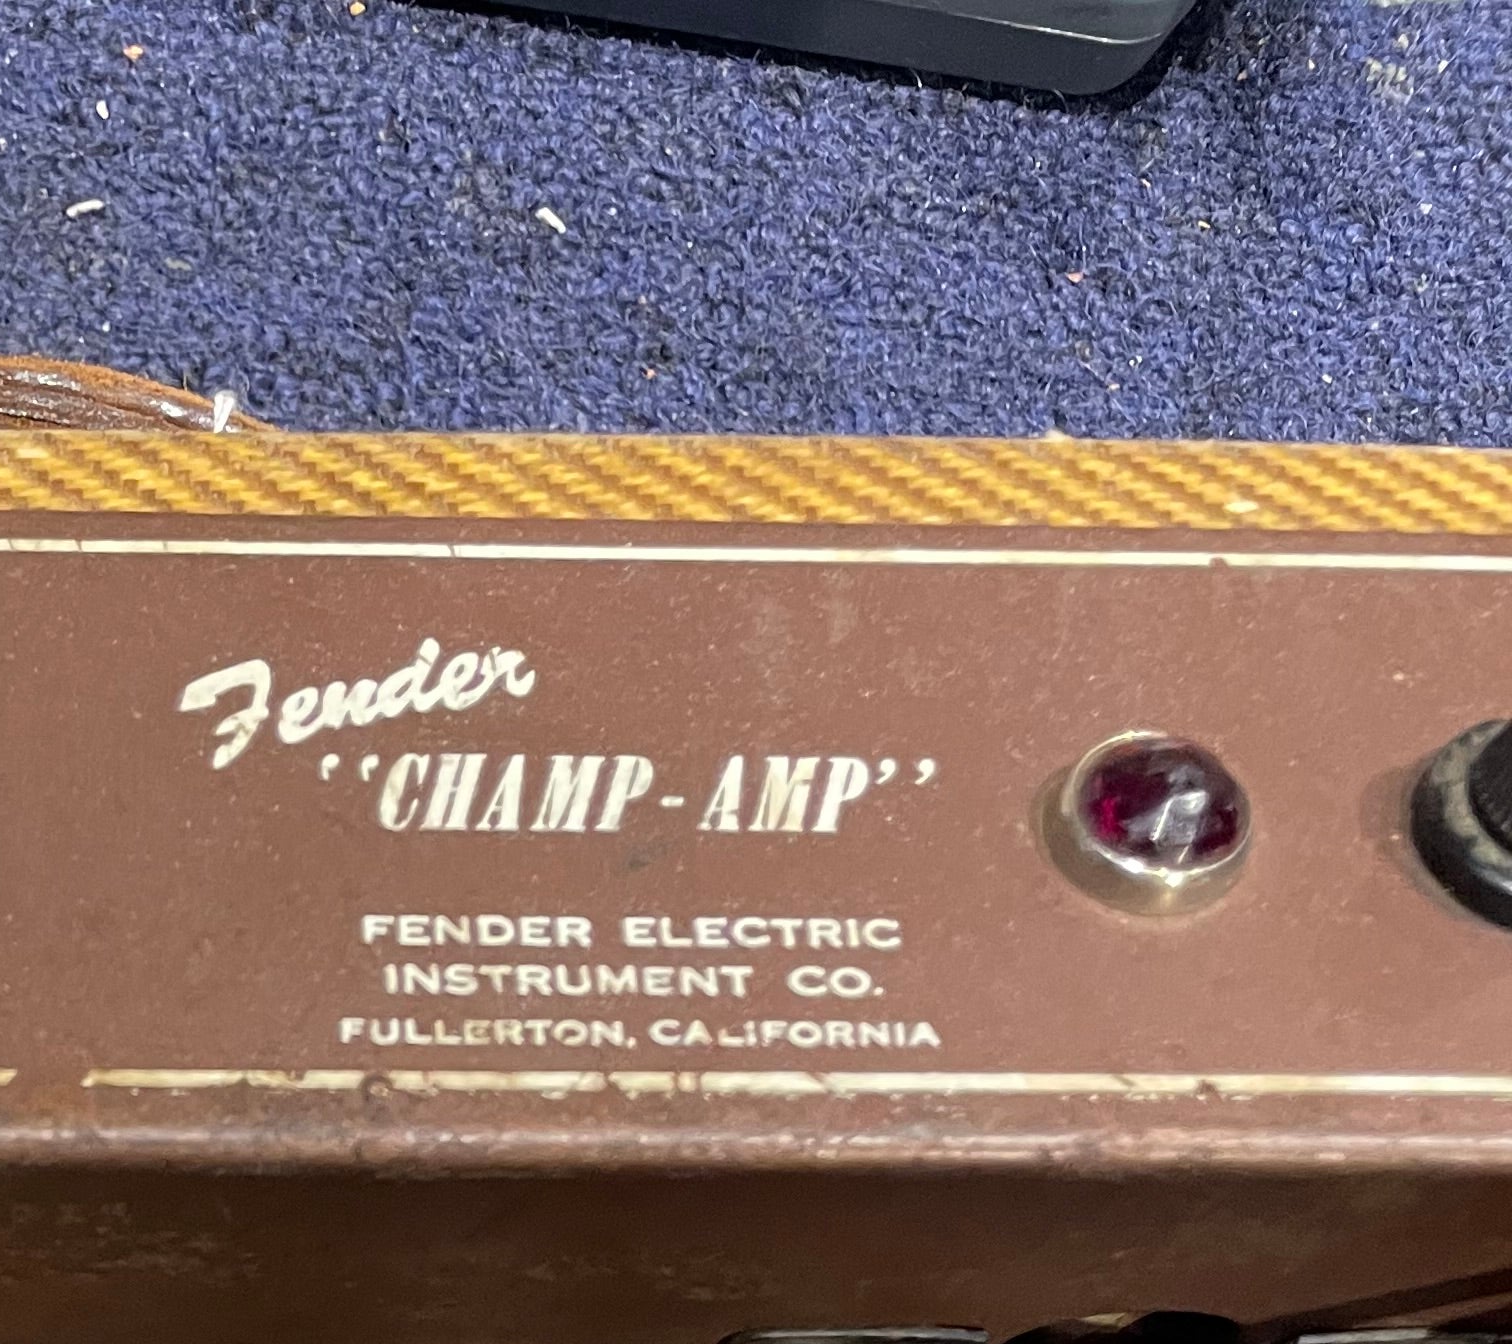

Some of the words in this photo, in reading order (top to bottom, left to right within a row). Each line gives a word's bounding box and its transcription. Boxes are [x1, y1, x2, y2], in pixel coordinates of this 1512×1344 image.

[179, 636, 536, 770] Fender
[360, 913, 593, 949] FENDER
[620, 914, 904, 951] ELECTRIC
[383, 962, 755, 999] INSTRUMENT
[785, 963, 886, 999] CO.
[339, 1015, 638, 1052] FULLERTON,
[648, 1016, 941, 1050] CALIFORNIA
